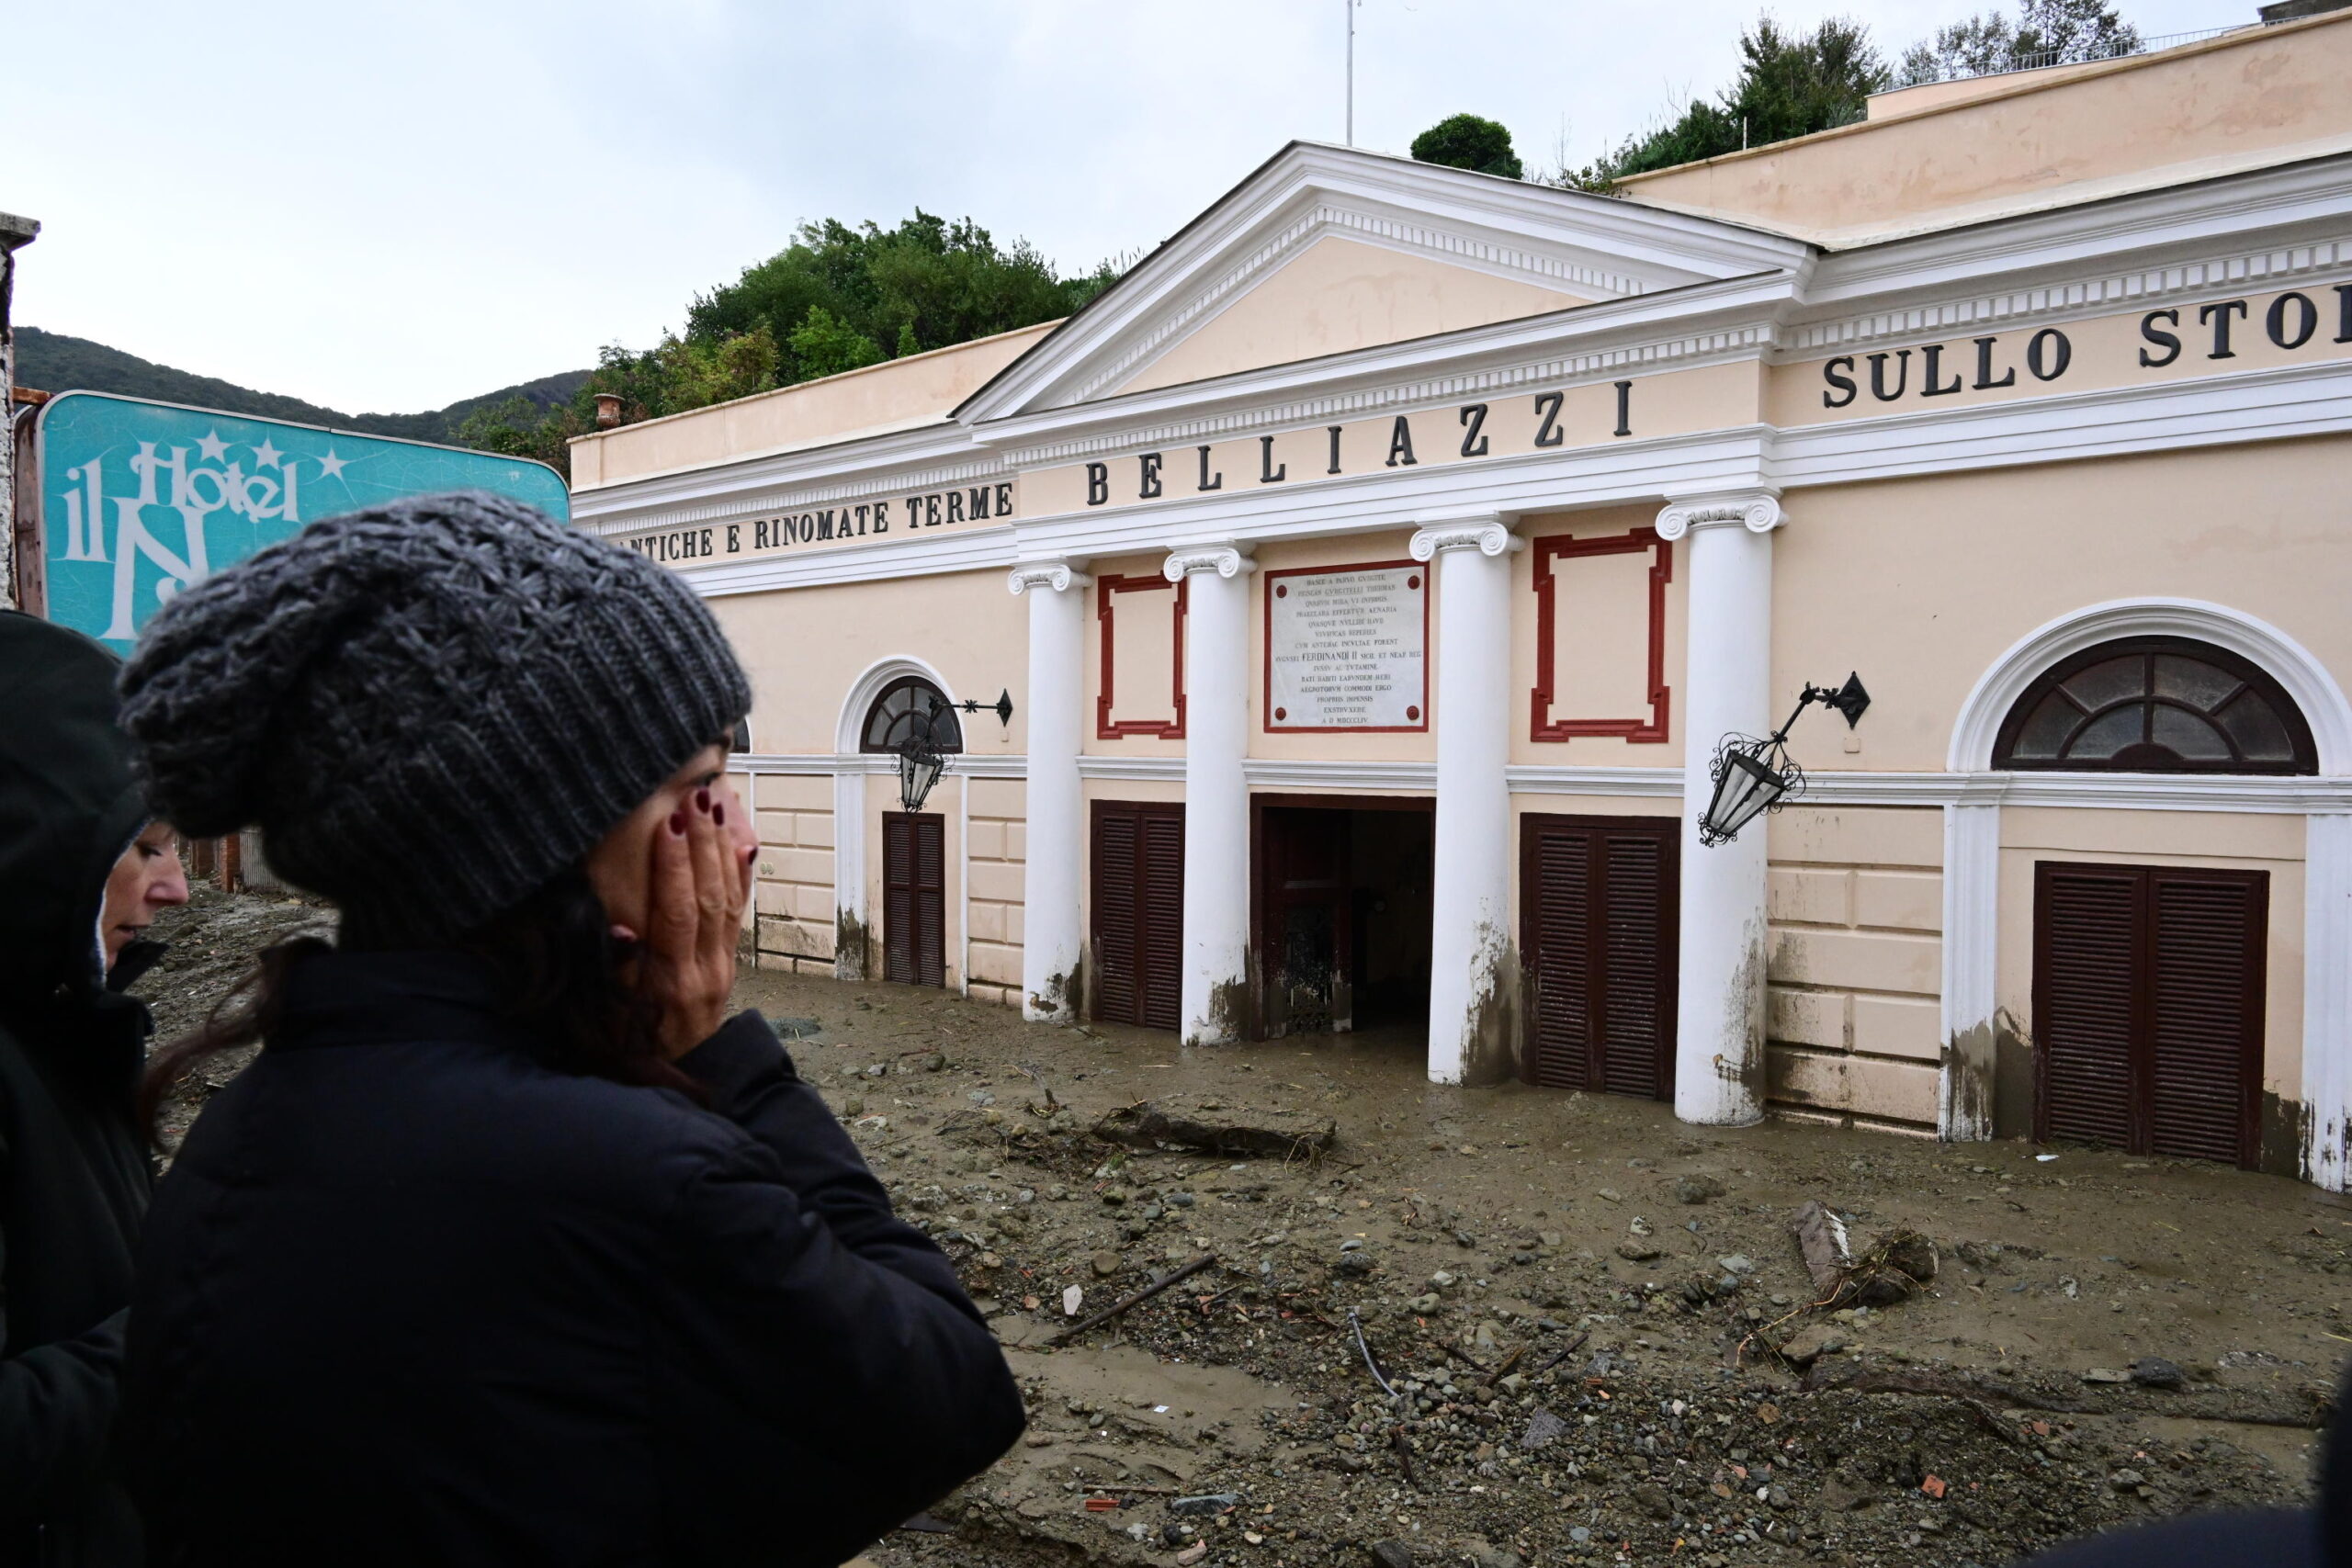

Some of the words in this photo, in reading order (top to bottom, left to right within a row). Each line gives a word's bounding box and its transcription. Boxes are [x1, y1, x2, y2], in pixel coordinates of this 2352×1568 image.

[1823, 328, 2072, 409] SULLO
[130, 440, 301, 524] Hotel
[1085, 380, 1633, 506] BELLIAZZI
[618, 528, 713, 562] NTICHE
[726, 525, 741, 553] E
[753, 502, 889, 549] RINOMATE
[906, 482, 1014, 530] TERME
[1302, 650, 1350, 661] FERDINANDI
[1346, 662, 1378, 671] TVTAMINE
